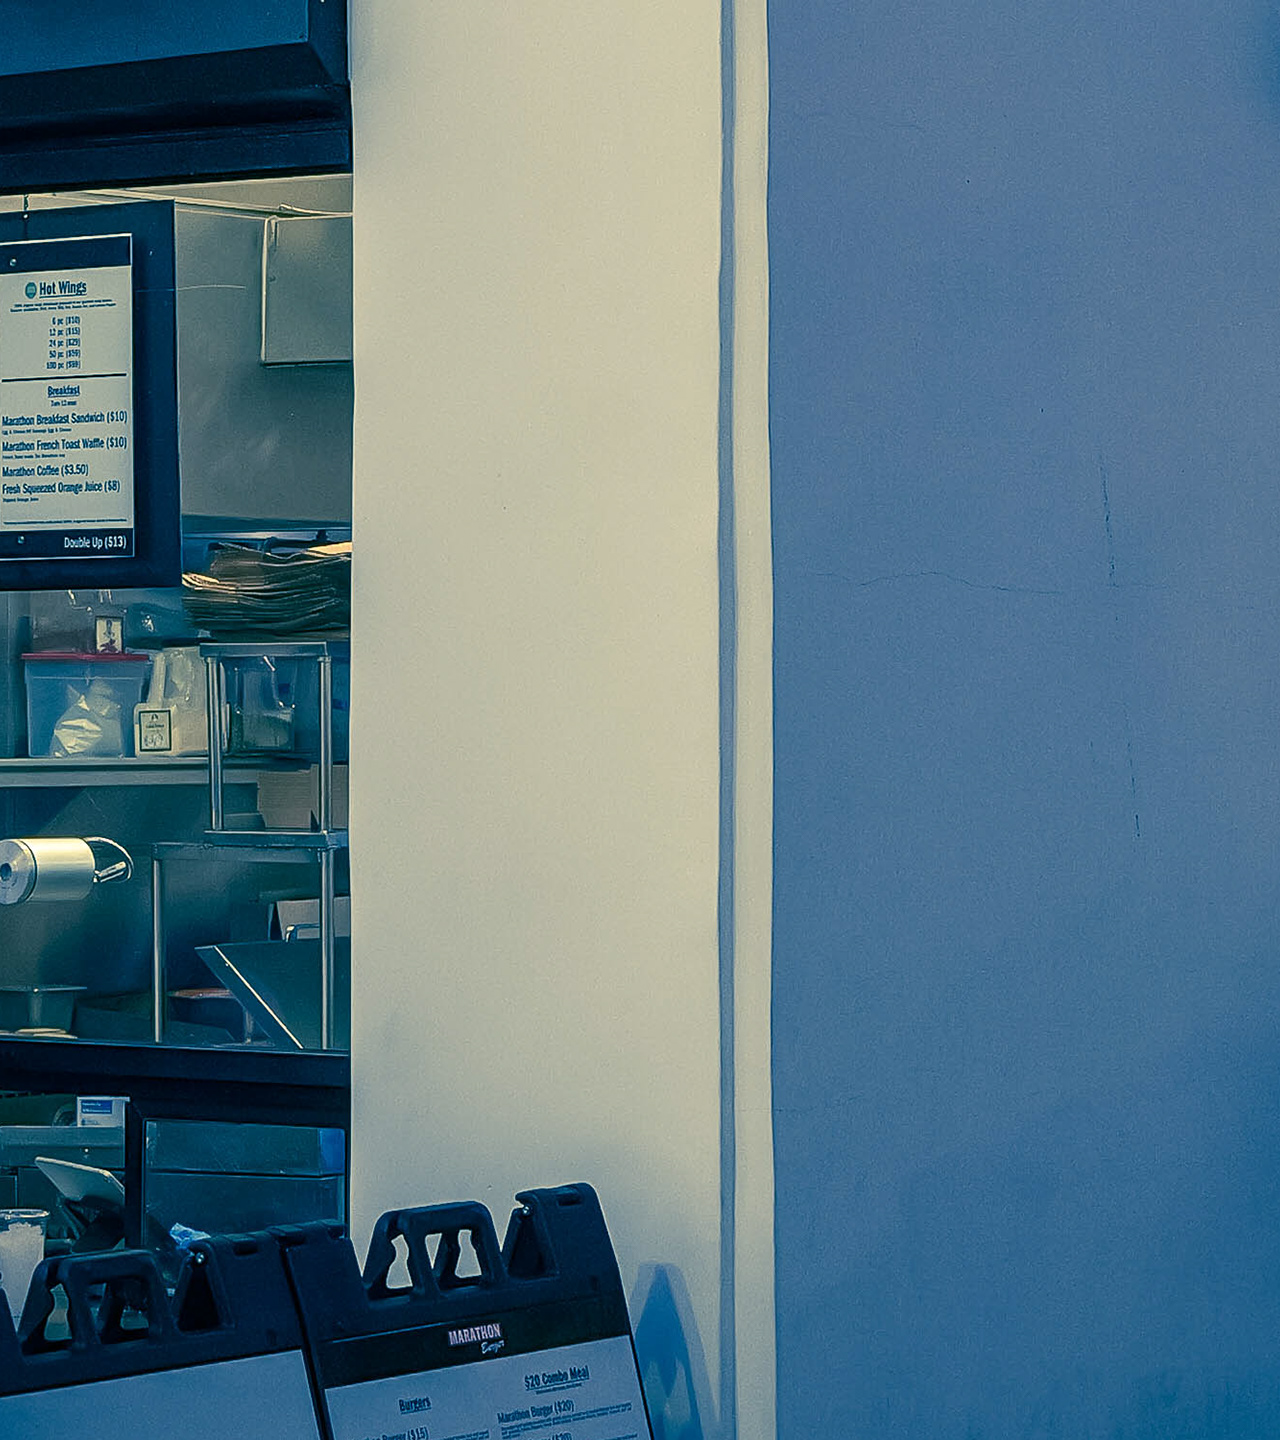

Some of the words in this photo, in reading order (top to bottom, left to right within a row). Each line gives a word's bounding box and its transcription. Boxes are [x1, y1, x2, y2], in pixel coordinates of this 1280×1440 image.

[40, 282, 55, 295] Hot
[59, 281, 86, 295] Wings
[48, 385, 80, 395] Breakfast
[2, 416, 34, 426] Marathon
[37, 414, 69, 425] Breakfast
[72, 413, 104, 424] Sandwich
[107, 411, 127, 424] ($10)
[2, 441, 34, 451] Marathon
[37, 440, 59, 450] French
[62, 439, 81, 449] Toast
[82, 438, 104, 448] Waffle
[107, 437, 127, 449] ($10)
[3, 466, 34, 477] Marathon
[37, 465, 59, 476] Coffee
[61, 464, 88, 476] ($3.50)
[3, 484, 20, 495] Fresh
[23, 483, 56, 495] Squeezed
[58, 482, 82, 494] Orange
[85, 481, 102, 492] Juice
[104, 480, 120, 493] ($8)
[64, 537, 90, 548] Double
[92, 537, 103, 548] Up
[105, 536, 126, 549] ($13)
[448, 1323, 501, 1345] MARATHON
